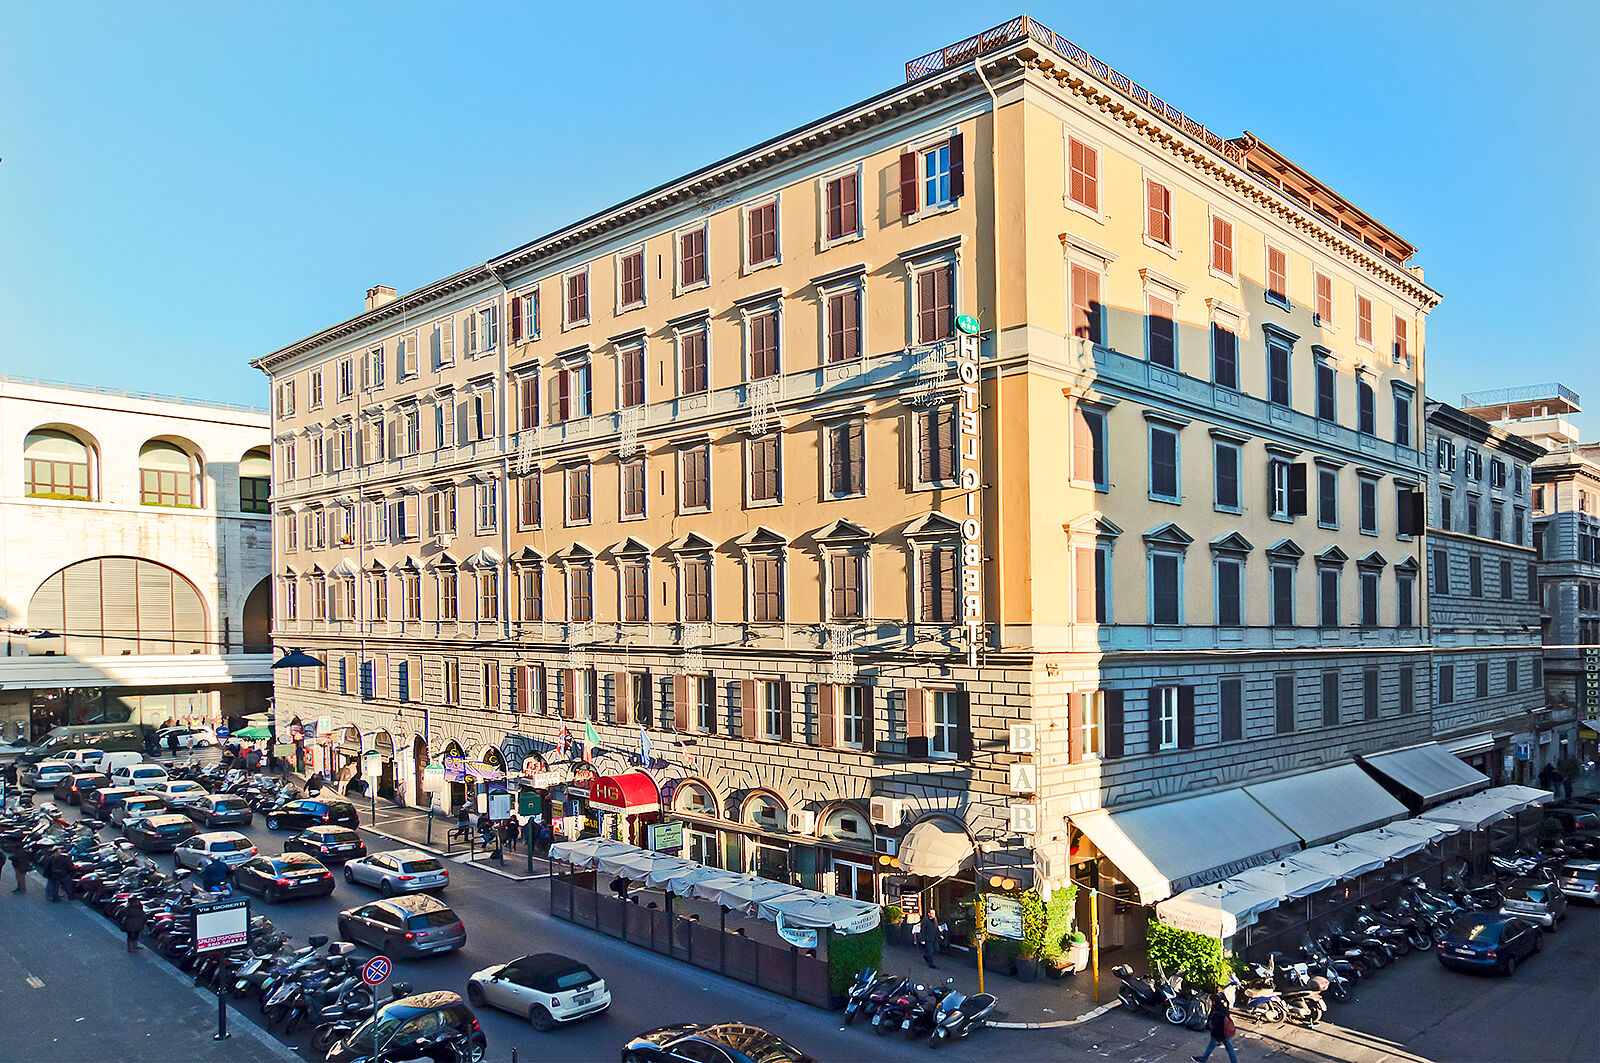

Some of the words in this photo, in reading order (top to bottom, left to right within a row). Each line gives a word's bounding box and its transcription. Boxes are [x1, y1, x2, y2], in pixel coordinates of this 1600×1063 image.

[1586, 648, 1599, 720] TRATTORIA
[596, 783, 619, 800] HG
[1013, 726, 1033, 829] BAR
[1188, 874, 1203, 887] LA
